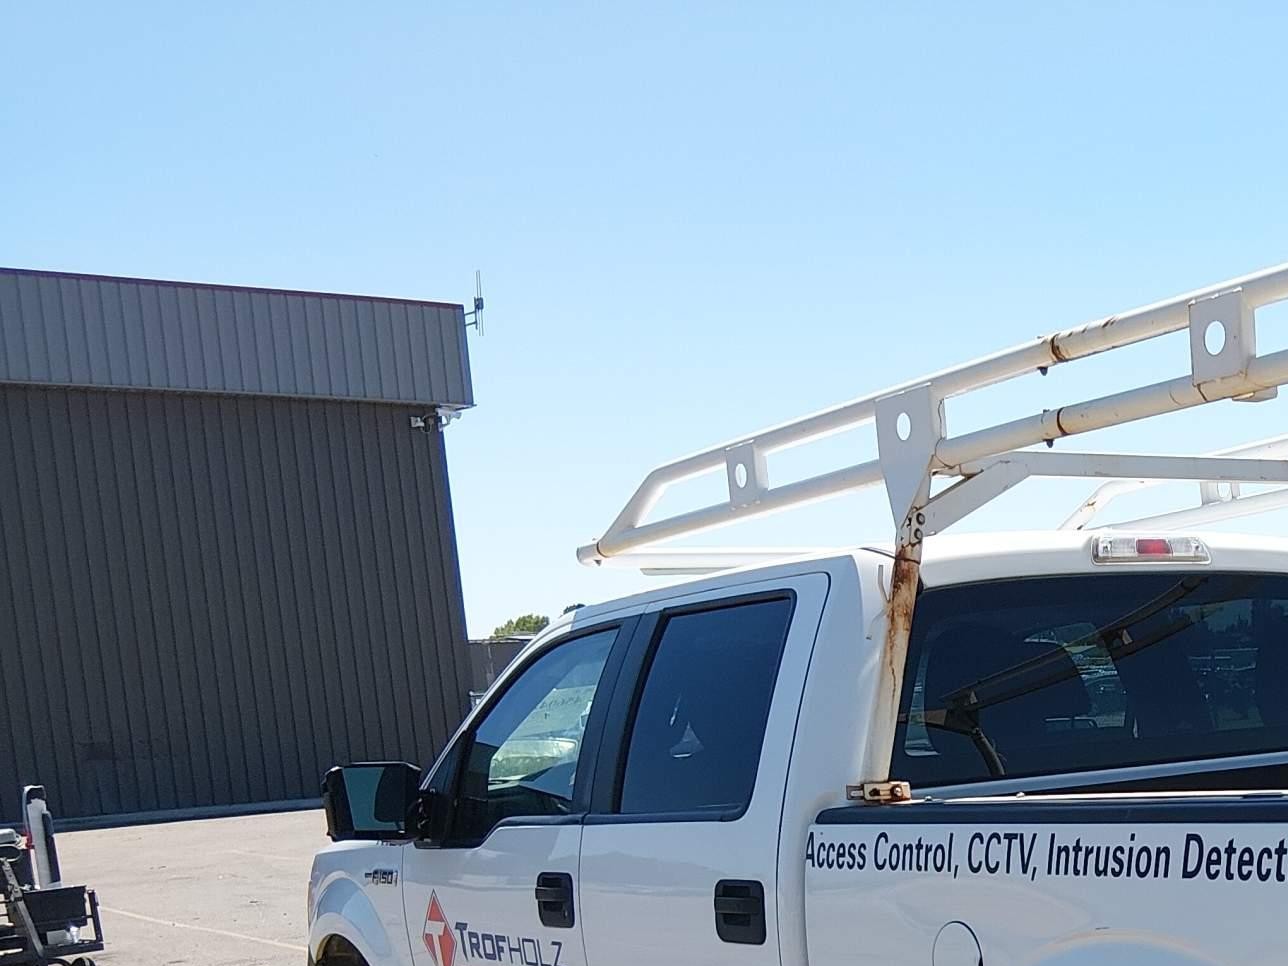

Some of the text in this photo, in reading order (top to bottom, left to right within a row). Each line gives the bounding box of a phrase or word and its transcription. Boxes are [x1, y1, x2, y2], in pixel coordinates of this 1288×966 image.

[805, 831, 867, 871] Access
[873, 831, 960, 880] Control,
[966, 831, 1038, 882] CCTV,
[1046, 832, 1172, 879] Intrusion
